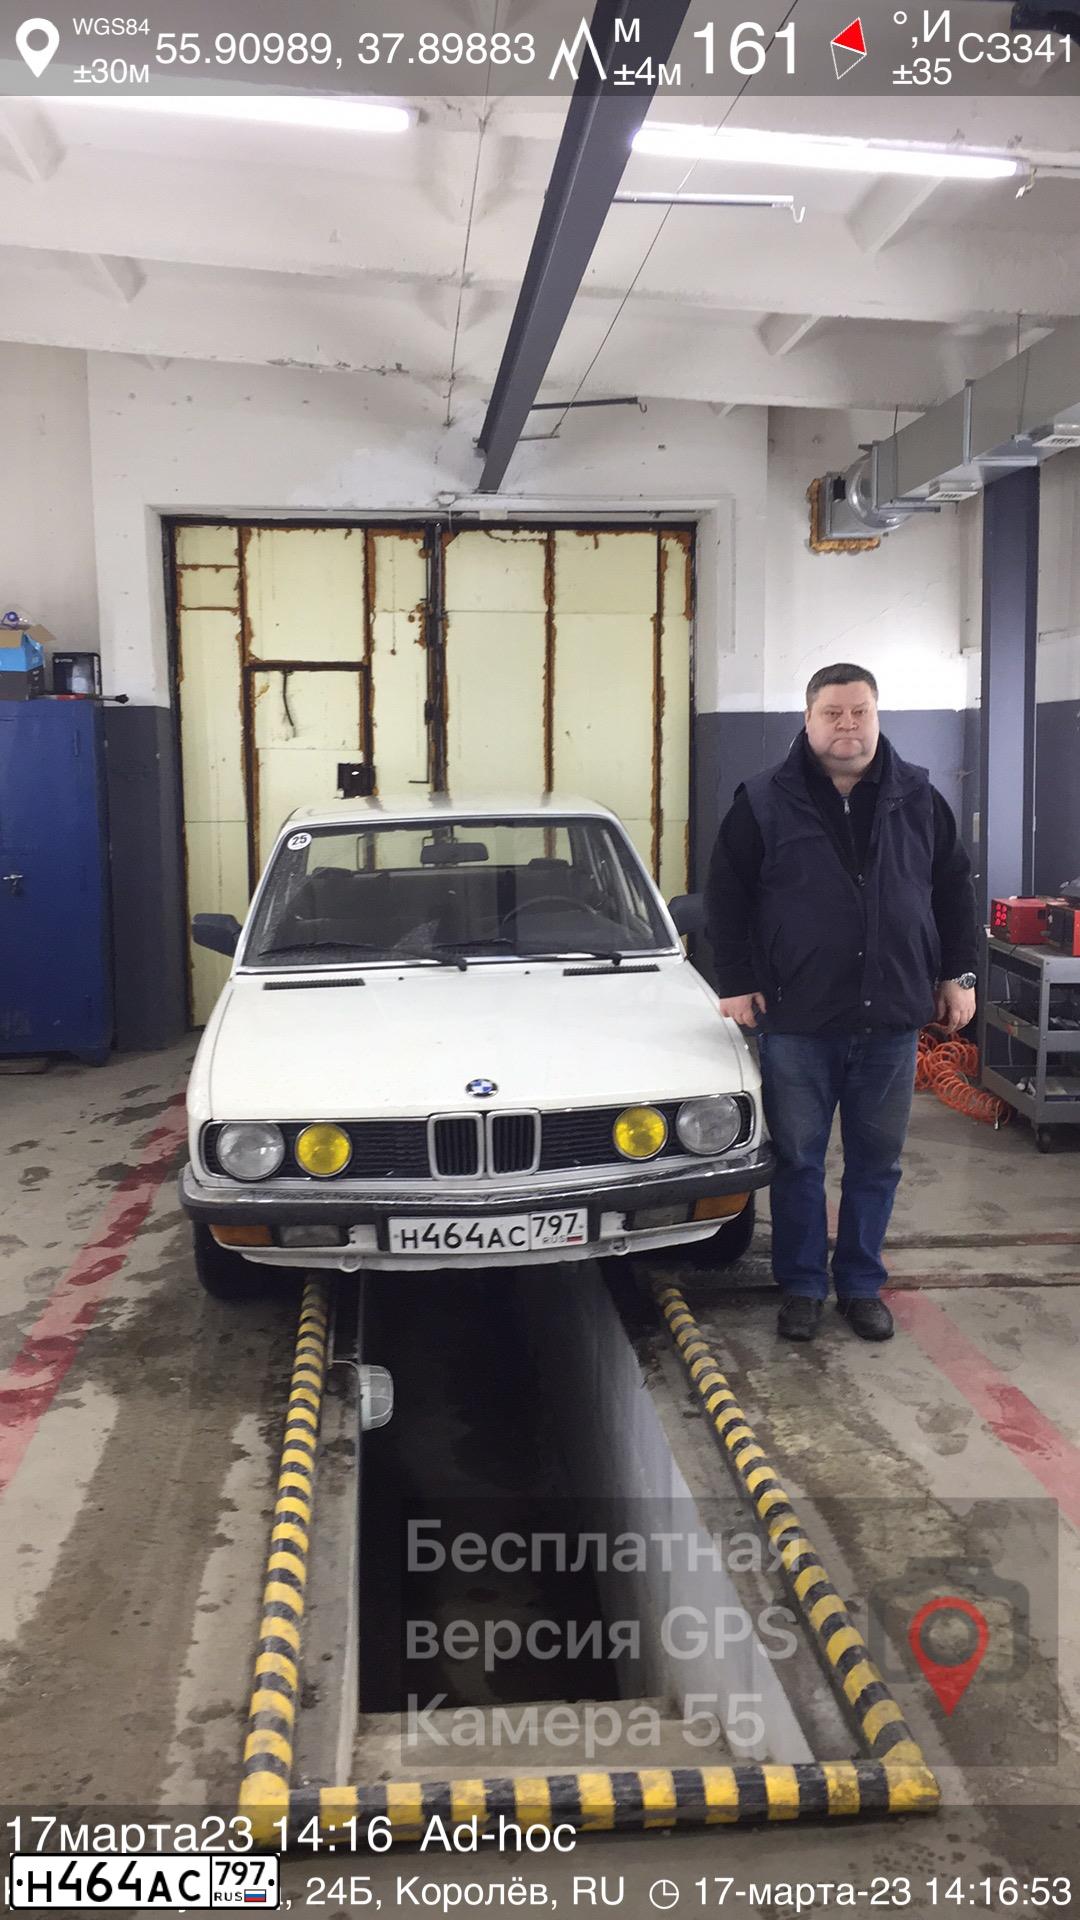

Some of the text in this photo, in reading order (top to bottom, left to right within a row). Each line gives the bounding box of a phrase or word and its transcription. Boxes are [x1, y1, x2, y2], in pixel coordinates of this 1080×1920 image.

[292, 834, 307, 846] 25
[532, 1212, 579, 1238] 797
[542, 1234, 566, 1246] RUS
